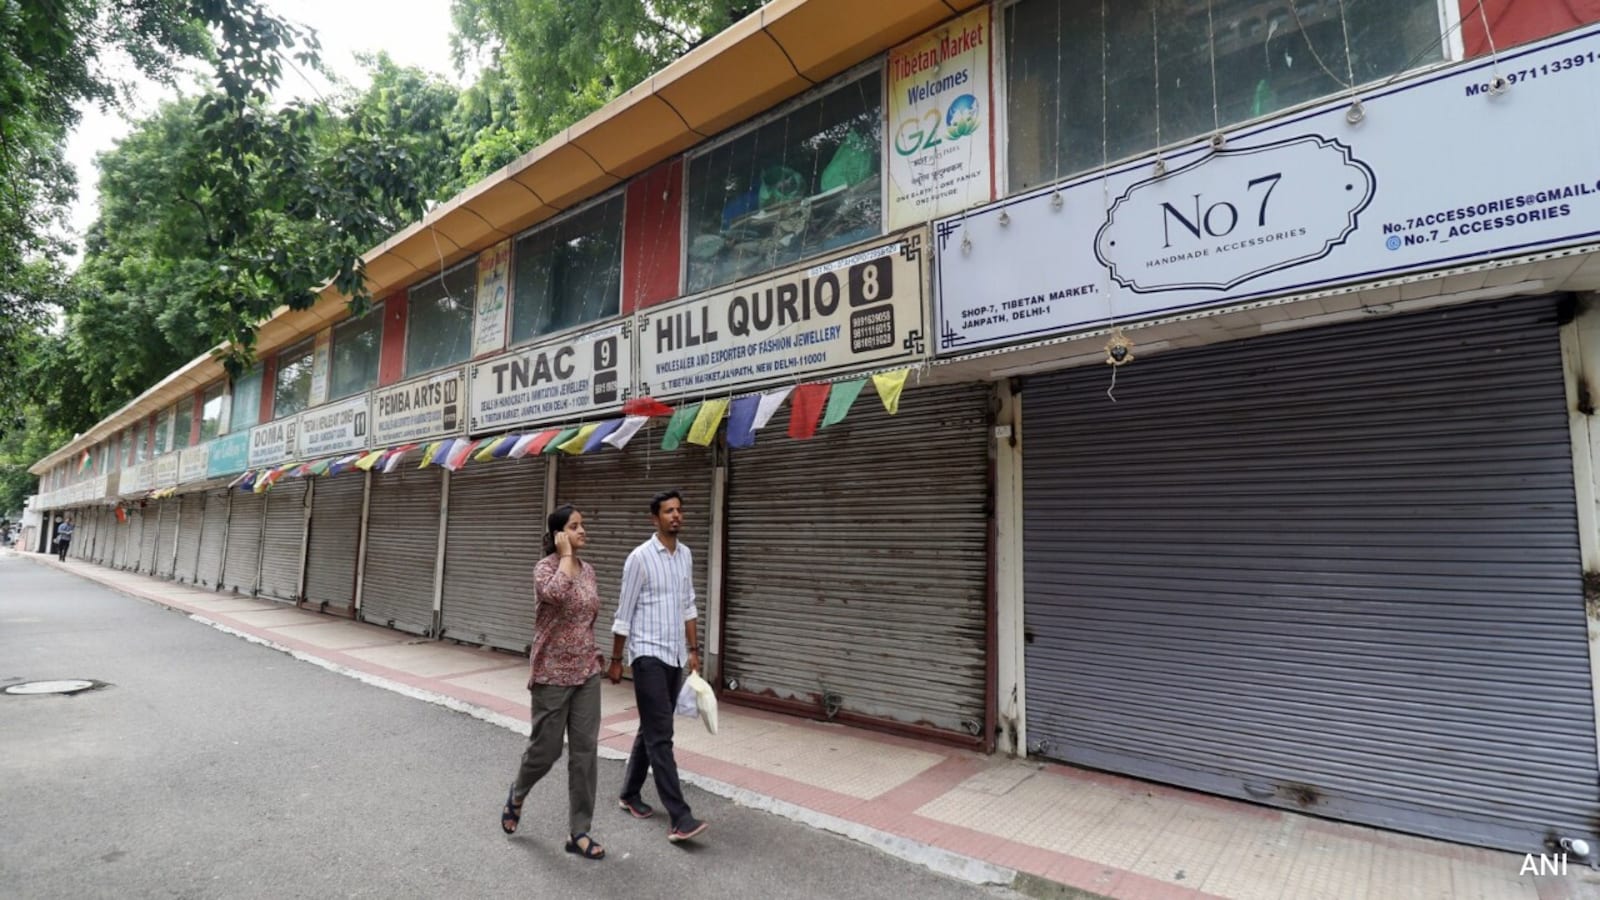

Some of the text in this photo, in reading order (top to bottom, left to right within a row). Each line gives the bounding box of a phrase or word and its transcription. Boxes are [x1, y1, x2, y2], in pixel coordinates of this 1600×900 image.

[895, 23, 983, 82] Tibetan Market
[1507, 51, 1600, 85] 97113391
[907, 68, 968, 105] Welcomes
[1158, 172, 1283, 249] No 7
[1145, 226, 1308, 269] HANDMADE ACCESSORIES
[862, 263, 880, 301] 8
[656, 271, 841, 354] HILL QURIO
[961, 283, 1099, 319] SHOP-7, TIBETAN MARKET,
[961, 305, 1051, 330] JANPATH, DELHI-1
[600, 340, 611, 367] 9
[655, 325, 842, 375] WHOLESALER AND EXPORTER OF FASHION JEWELLERY
[492, 345, 576, 395] TNAC
[559, 379, 589, 396] JEWELLERY
[668, 375, 694, 389] TIBETAN
[755, 361, 773, 373] NEW
[774, 351, 827, 371] DELHI-110001
[379, 381, 442, 417] PEMBA ARTS
[445, 380, 456, 403] 10
[541, 402, 553, 413] NEW
[553, 399, 568, 411] DELHI
[253, 425, 284, 448] DOMA
[355, 412, 365, 436] 11
